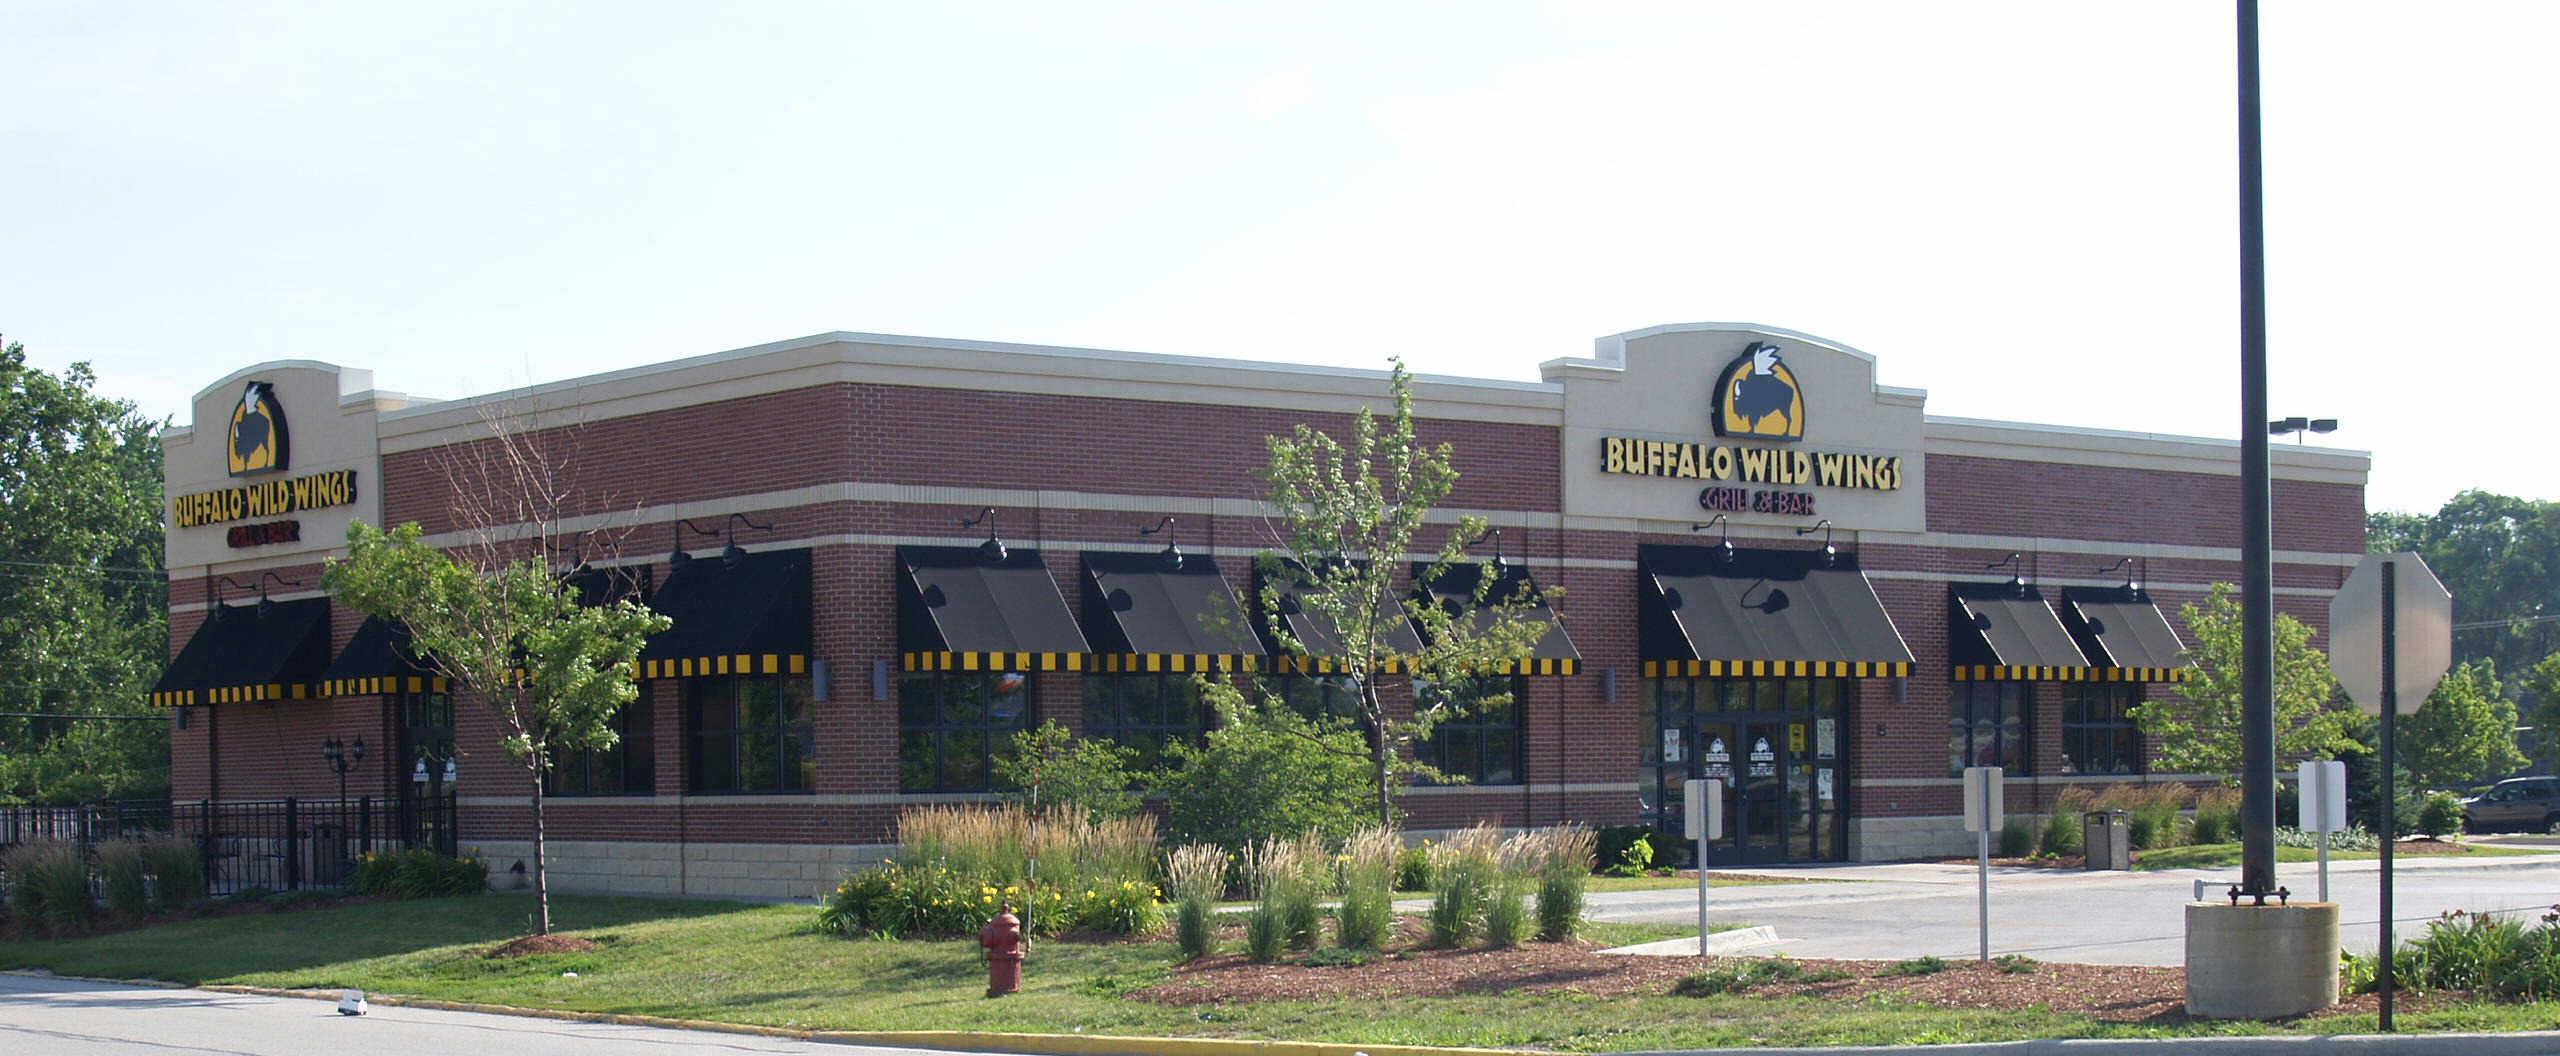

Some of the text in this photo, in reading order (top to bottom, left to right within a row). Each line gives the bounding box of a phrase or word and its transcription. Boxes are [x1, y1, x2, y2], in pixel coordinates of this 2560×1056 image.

[1606, 437, 1902, 490] BUFFALO WILD WINGS
[174, 469, 350, 528] BUFFALO WILD WINGS
[1705, 487, 1816, 515] GRILL & BAR
